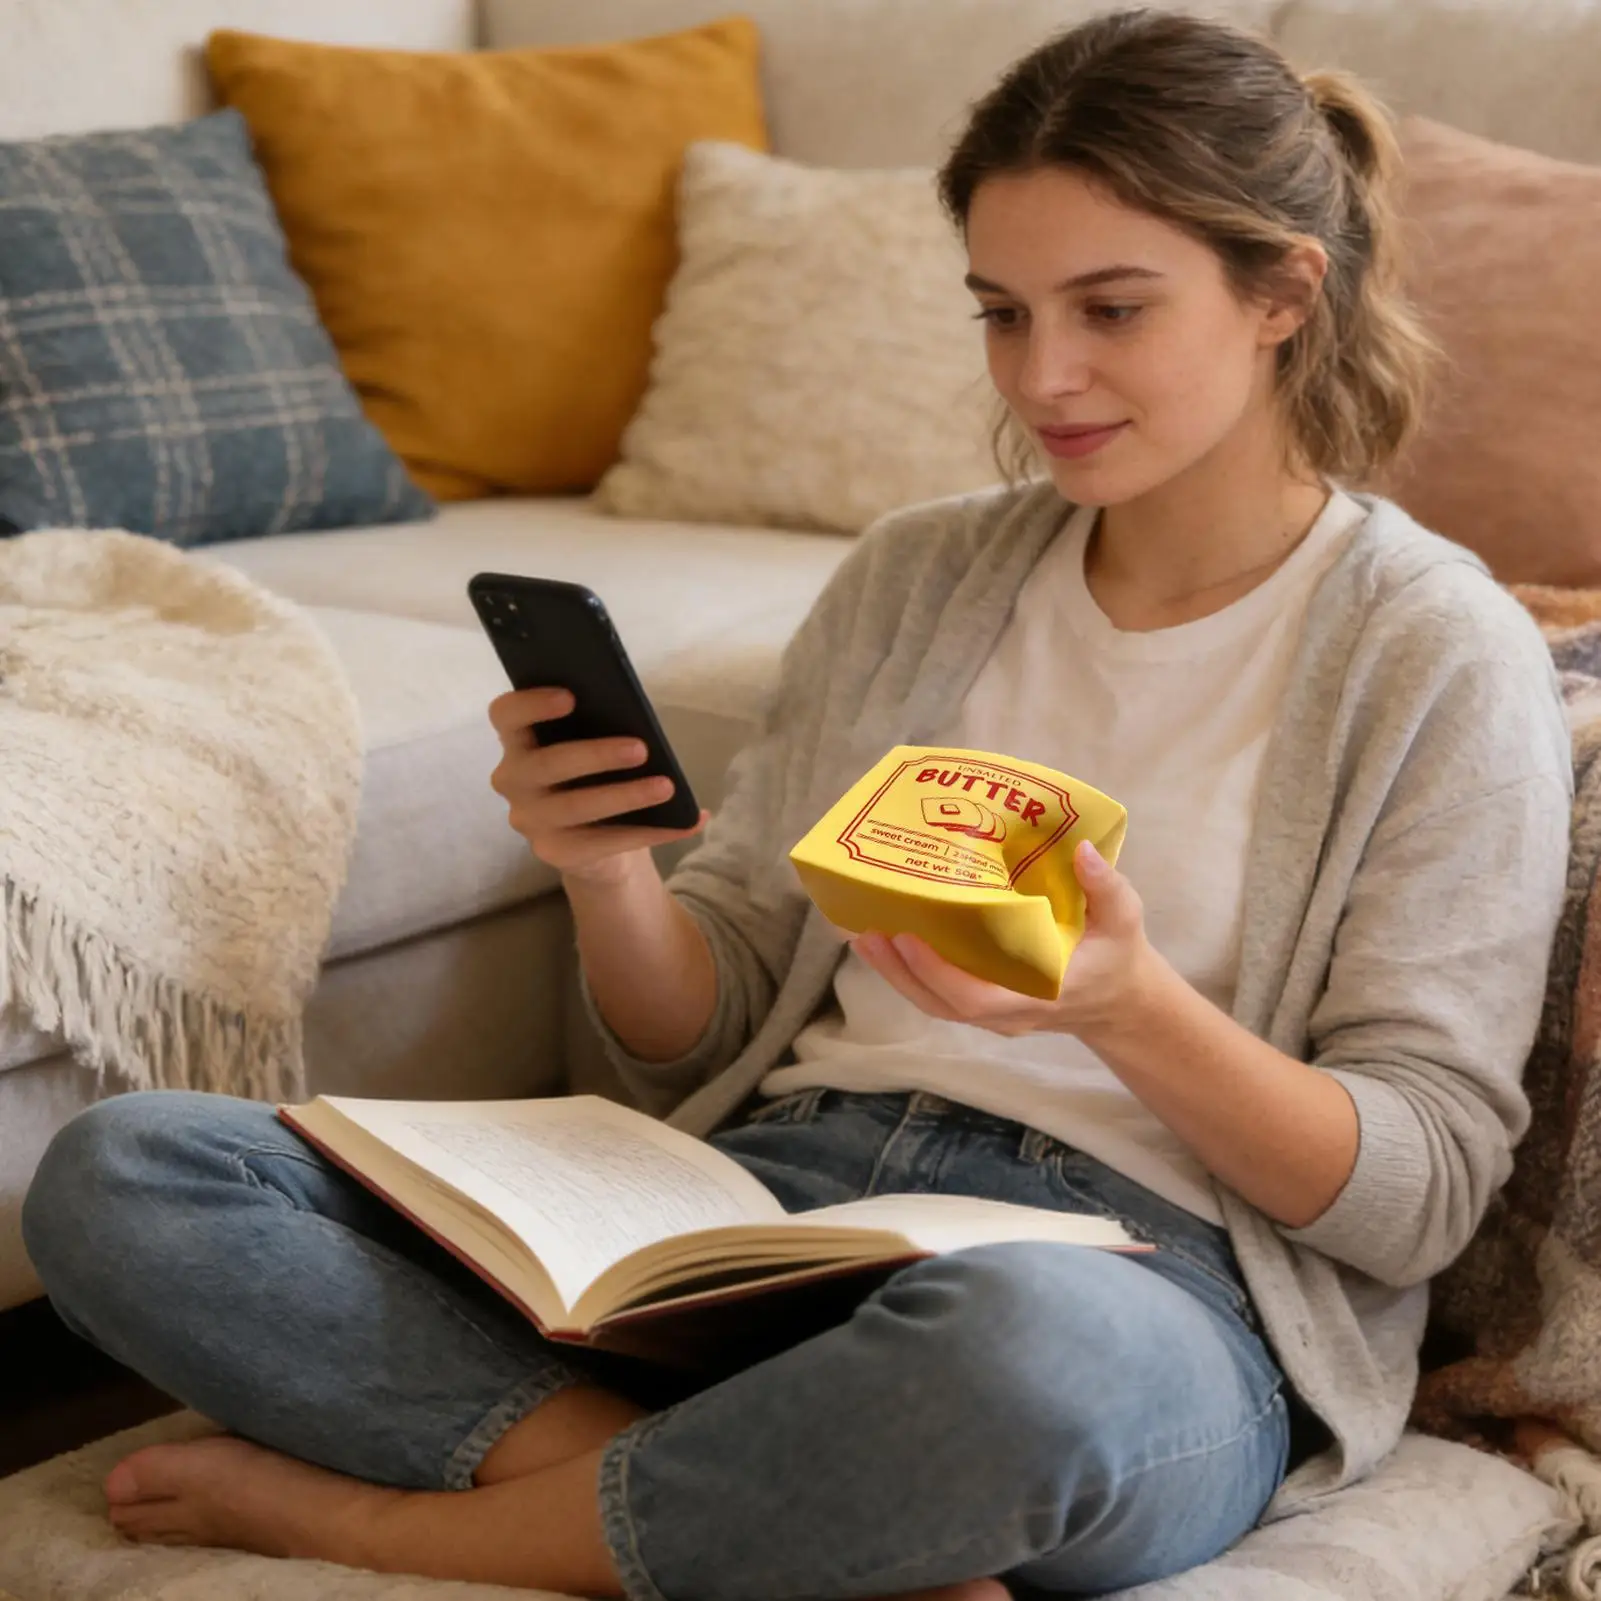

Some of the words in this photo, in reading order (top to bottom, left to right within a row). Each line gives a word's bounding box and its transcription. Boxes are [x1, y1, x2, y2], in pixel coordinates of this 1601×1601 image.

[957, 765, 1022, 787] UNSALTED
[915, 768, 1046, 827] BUTTER
[871, 828, 903, 842] sweet
[903, 836, 939, 851] cream
[904, 856, 929, 869] net
[932, 862, 951, 873] wt
